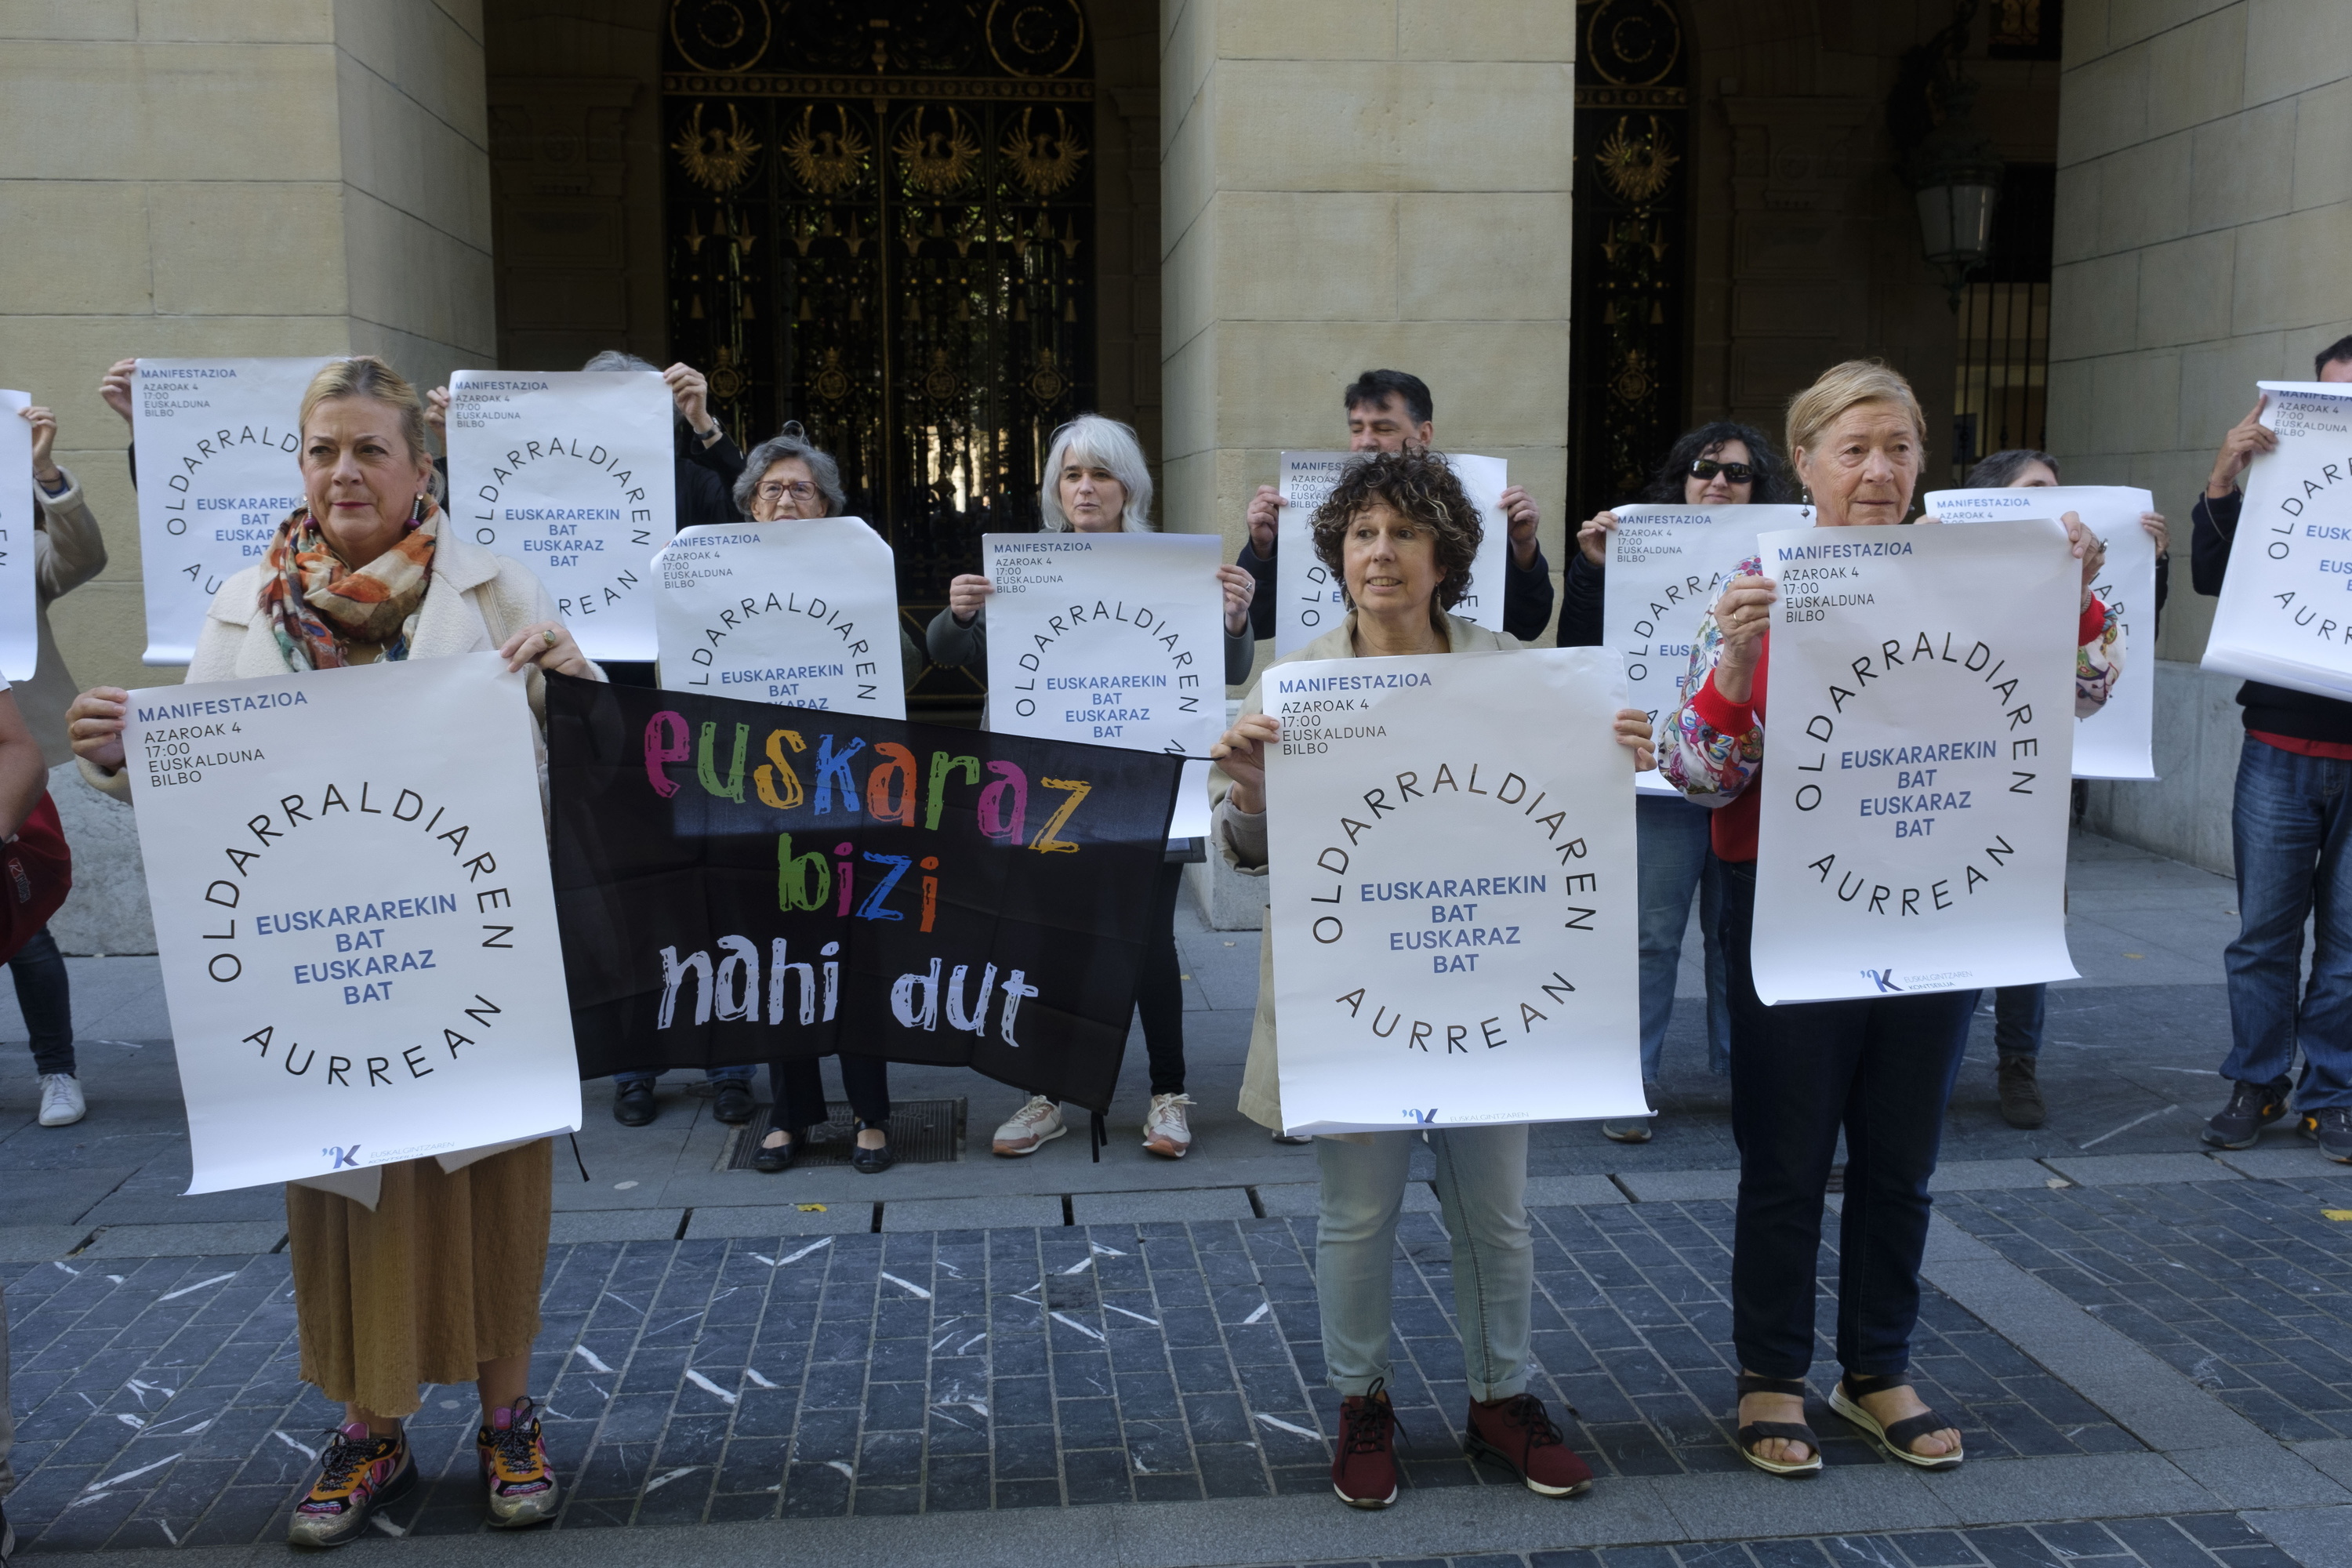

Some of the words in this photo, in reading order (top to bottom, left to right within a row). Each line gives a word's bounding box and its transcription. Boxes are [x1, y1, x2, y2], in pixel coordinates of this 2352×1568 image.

[141, 368, 237, 379] MANIFESTAZIOA
[143, 383, 190, 391] AZAROAK
[455, 381, 549, 390] MANIFESTAZIOA
[2277, 411, 2303, 420] 17:00
[2278, 403, 2329, 414] AZAROAK
[2274, 427, 2305, 437] BILBO
[2275, 419, 2347, 433] EUSKALDUNA
[165, 426, 299, 535] OLDARRALD
[475, 437, 651, 545] OLDARRALDIAREN
[198, 497, 298, 510] EUSKARAREK
[1936, 499, 2031, 508] MANIFESTAZIOA
[241, 514, 270, 525] BAT
[505, 509, 619, 521] EUSKARAREKIN
[1618, 516, 1711, 524] MANIFESTAZIOA
[216, 529, 275, 541] EUSKAR
[549, 524, 577, 535] BAT
[524, 539, 604, 551] EUSKARAZ
[669, 534, 760, 548] ANIFESTAZIOA
[994, 543, 1091, 554] MANIFESTAZIOA
[662, 552, 711, 561] AZAROAK
[1778, 542, 1913, 561] MANIFESTAZIOA
[550, 556, 579, 566] BAT
[662, 561, 689, 570] 17:00
[664, 568, 733, 580] EUSKALDUNA
[996, 567, 1021, 575] 17:00
[1783, 568, 1847, 582] AZAROAK
[1851, 566, 1860, 577] 4
[665, 579, 695, 588] BILBO
[996, 575, 1063, 584] EUSKALDUNA
[559, 569, 638, 616] REAN
[996, 585, 1025, 593] BILBO
[1783, 583, 1819, 594] 17:00
[1786, 593, 1875, 608] EUSKALDUNA
[1786, 610, 1825, 622] BILBO
[1628, 572, 1720, 681] OLDARRA
[688, 592, 877, 699] LDARRALDIAREN
[1014, 601, 1199, 717] OLDARRALDIAREN
[721, 663, 844, 684] EUSKARAREKIN
[1047, 675, 1167, 690] EUSKARAREKIN
[1279, 673, 1432, 693] MANIFESTAZIOA
[769, 684, 800, 697] BAT
[138, 691, 308, 723] MANIFESTAZIOA
[1093, 693, 1123, 706] BAT
[1281, 699, 1355, 713] AZAROAK
[1360, 699, 1369, 710] 4
[1065, 709, 1150, 722] EUSKARAZ
[1281, 715, 1321, 728] 17:00
[1795, 632, 2038, 811] OLDARRALDIAREN
[144, 723, 226, 743] AZAROAK
[232, 722, 241, 734] 4
[1093, 726, 1123, 738] BAT
[1283, 726, 1386, 742] EUSKALDUNA
[146, 742, 190, 758] 17:00
[1283, 742, 1328, 756] BILBO
[1841, 740, 1996, 770] EUSKARAREKIN
[149, 749, 265, 773] EUSKALDUNA
[151, 770, 202, 787] BILBO
[644, 710, 1093, 854] euskaraz
[1897, 769, 1937, 789] BAT
[1860, 790, 1971, 817] EUSKARAZ
[1896, 818, 1935, 839] BAT
[1311, 763, 1596, 944] OLDARRALDIAREN
[202, 782, 514, 982] OLDARRALDIAREN
[778, 833, 939, 933] bizi
[1808, 834, 2015, 917] AURREAN
[1361, 875, 1546, 902] EUSKARAREKIN
[256, 893, 458, 935] EUSKARAREKIN
[1432, 903, 1478, 924] BAT
[336, 928, 386, 953] BAT
[1389, 927, 1521, 950] EUSKARAZ
[294, 949, 436, 985] EUSKARAZ
[1433, 953, 1479, 974] BAT
[1904, 971, 1973, 983] EUSKALGINTZAREN
[343, 981, 394, 1005] BAT
[657, 934, 839, 1030] nahi
[891, 957, 1040, 1048] dut
[1908, 982, 1955, 991] KONTSEILUA
[1336, 971, 1576, 1054] AURREAN
[241, 994, 502, 1087] AURREAN
[370, 1142, 455, 1159] EUSKALGINTZAREN
